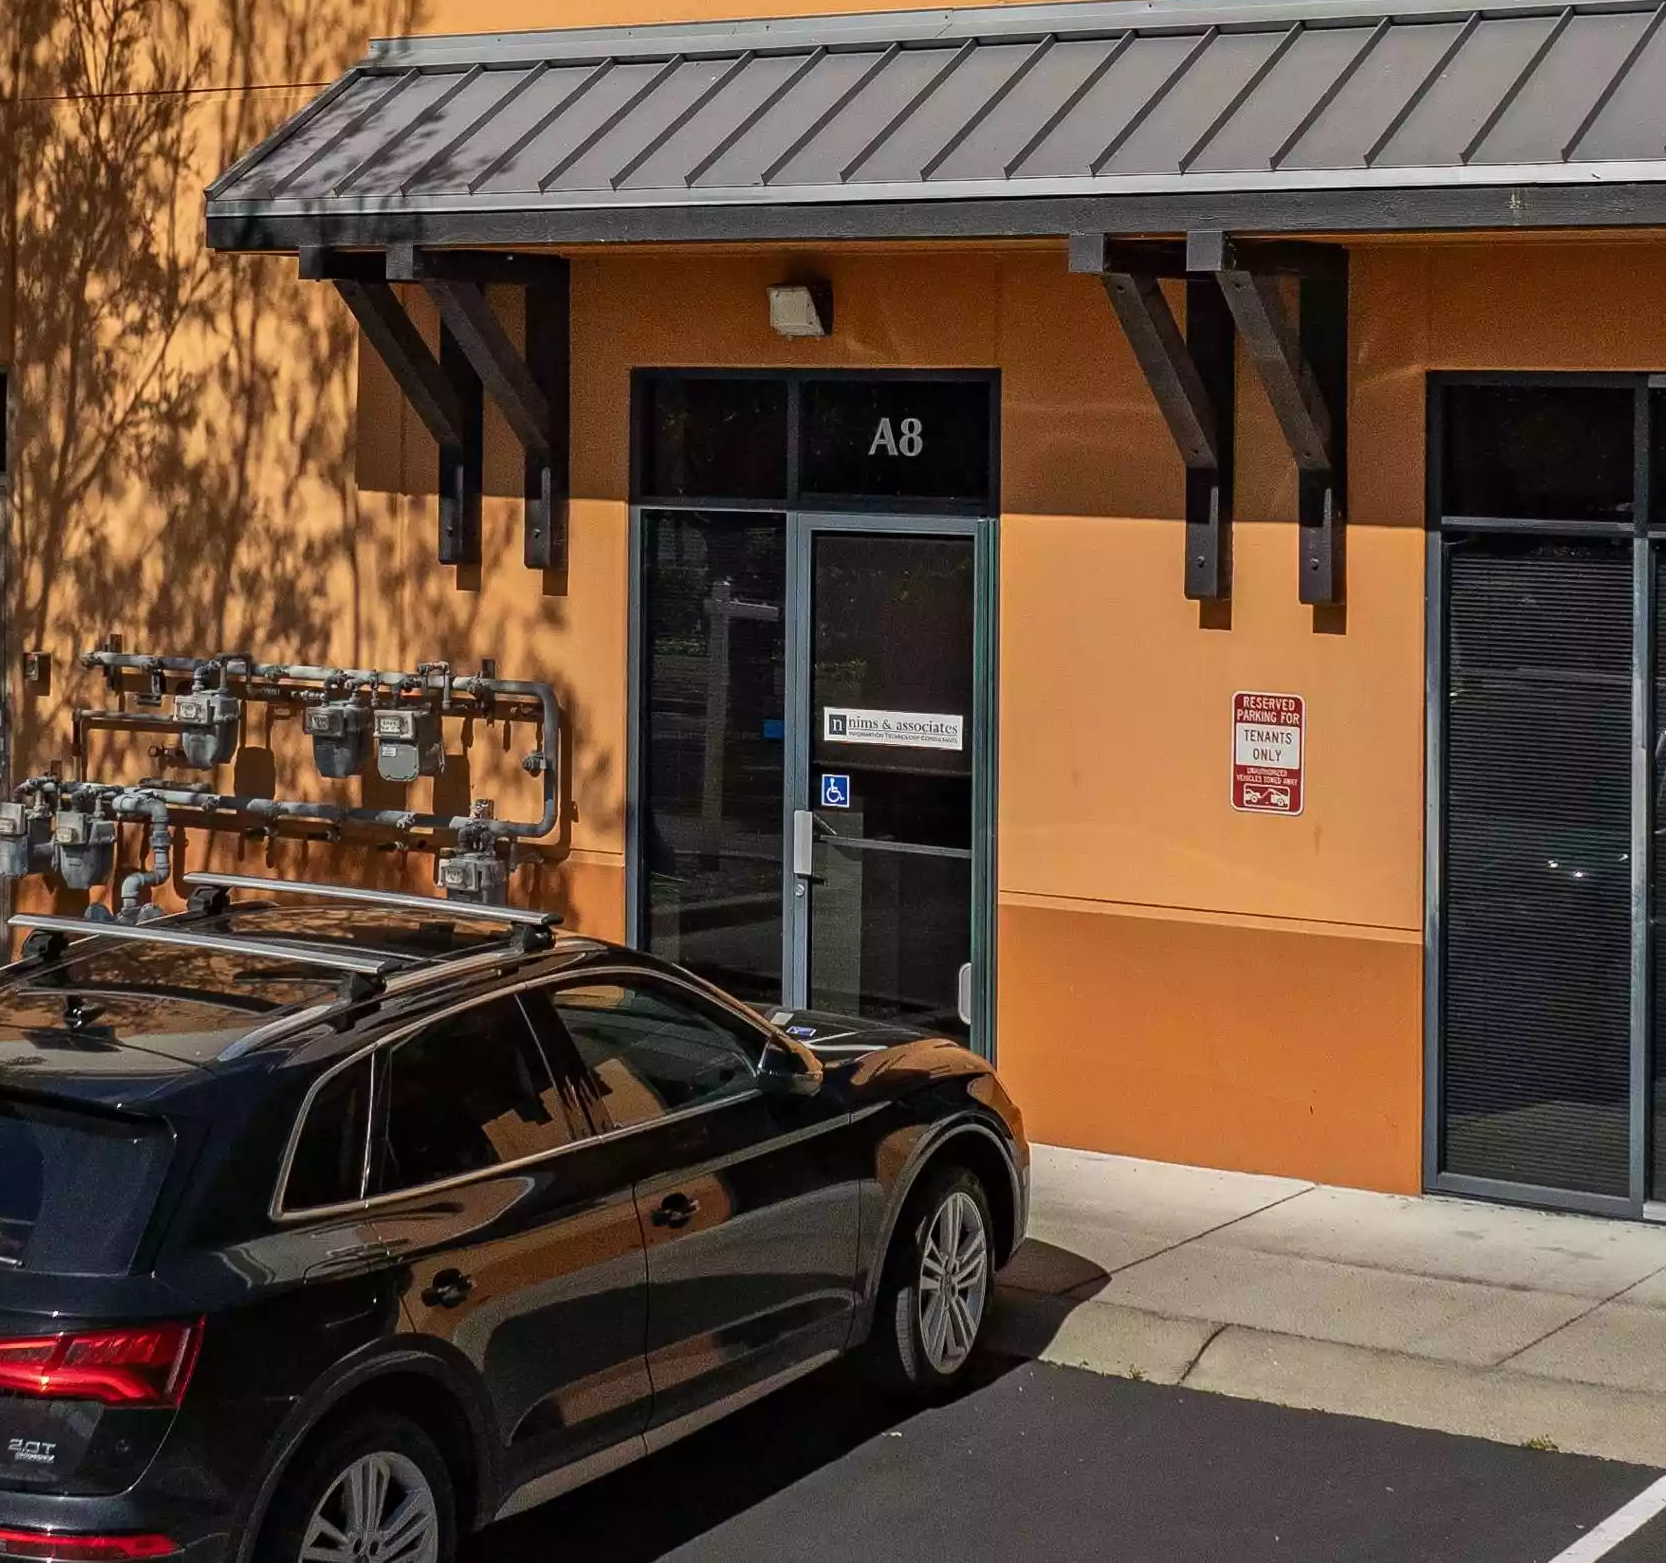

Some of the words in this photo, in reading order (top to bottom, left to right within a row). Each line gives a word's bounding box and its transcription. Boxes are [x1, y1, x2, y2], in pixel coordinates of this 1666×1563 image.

[868, 417, 924, 457] A8
[1243, 696, 1295, 711] RESERVED
[1236, 709, 1277, 723] PARKING
[1280, 713, 1300, 725] FOR
[848, 716, 879, 730] nims
[881, 719, 892, 730] &
[896, 720, 958, 735] associates
[1244, 729, 1293, 745] TENANTS
[1253, 748, 1282, 762] ONLY
